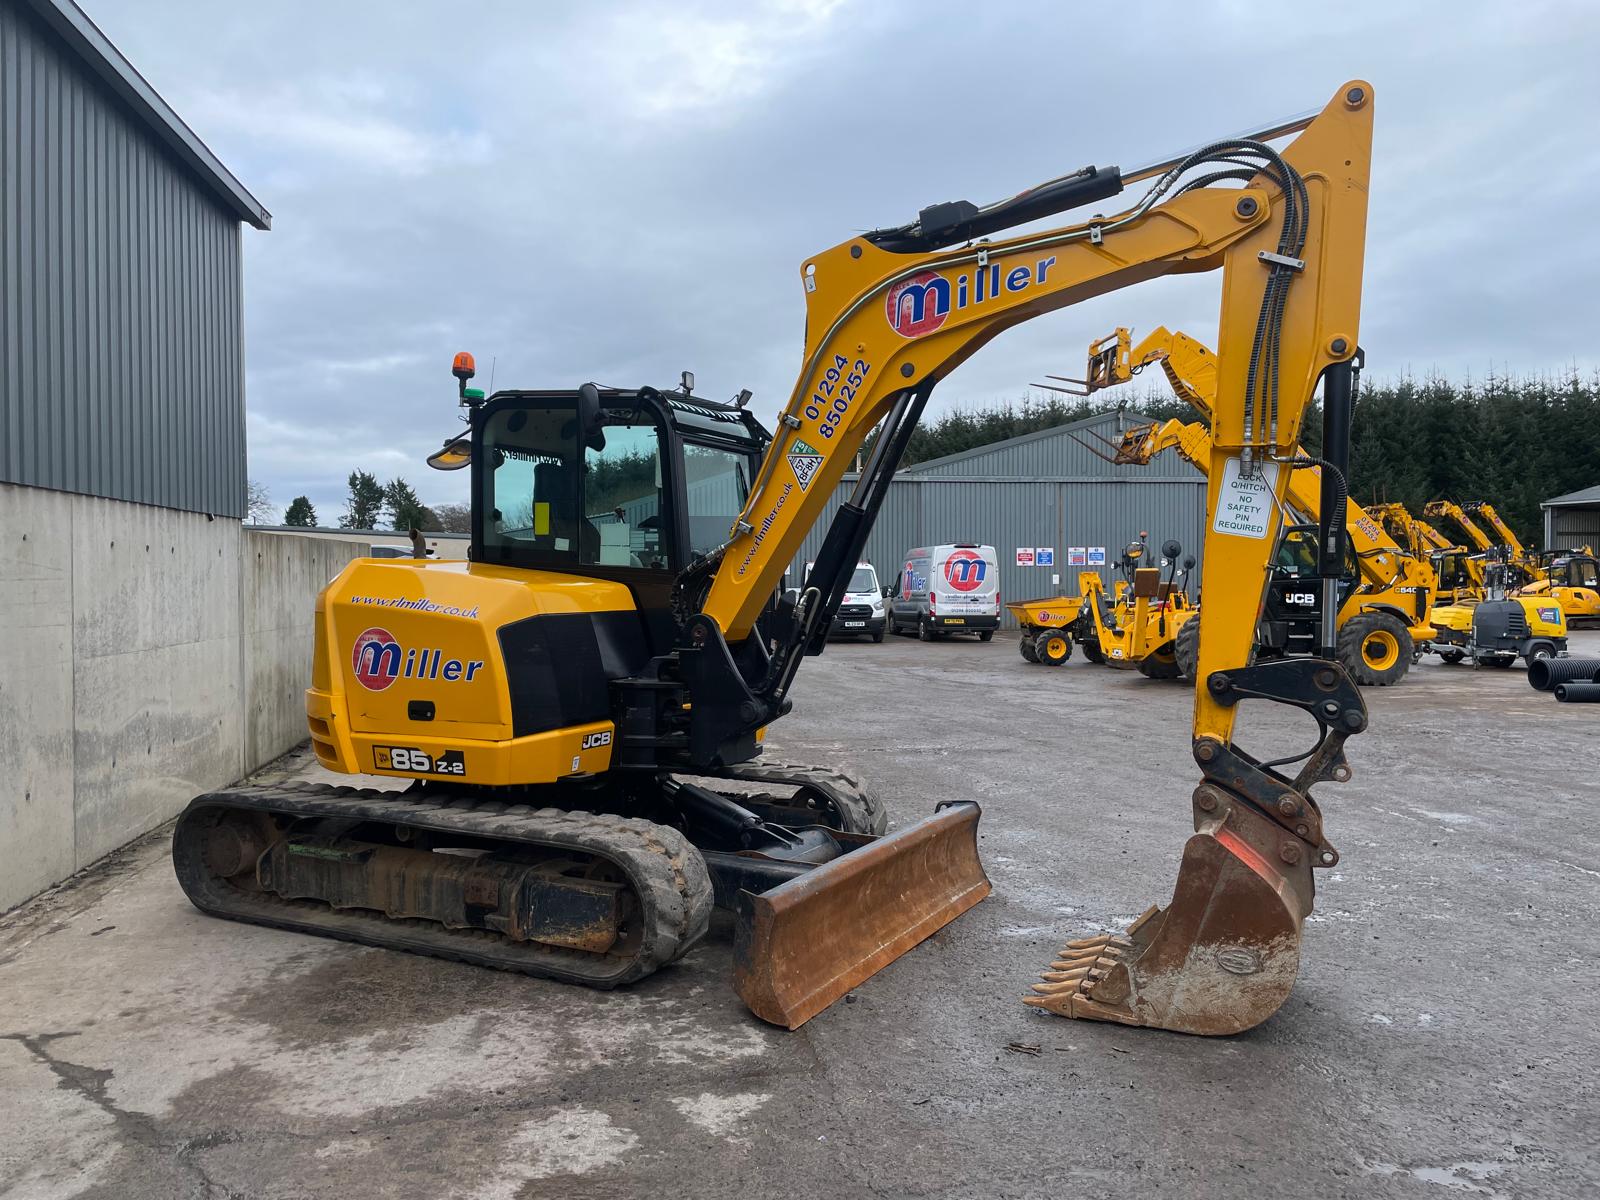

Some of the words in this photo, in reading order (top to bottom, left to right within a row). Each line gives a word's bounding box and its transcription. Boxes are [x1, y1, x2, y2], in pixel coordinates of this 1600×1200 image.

[895, 255, 1056, 330] Miller
[804, 354, 849, 421] 01294
[819, 359, 871, 439] 850252
[1231, 481, 1266, 492] Q/HITCH
[1227, 503, 1262, 514] SAFETY
[1239, 495, 1253, 503] NO
[1218, 520, 1263, 533] REQUIRED
[1235, 513, 1250, 522] PIN
[739, 482, 793, 575] www.rlmiller.co.uk
[351, 595, 479, 619] www.rlmiller.co.uk
[1285, 593, 1315, 604] JCB
[355, 640, 484, 683] Miller
[582, 731, 611, 749] JCB
[391, 748, 430, 771] 85
